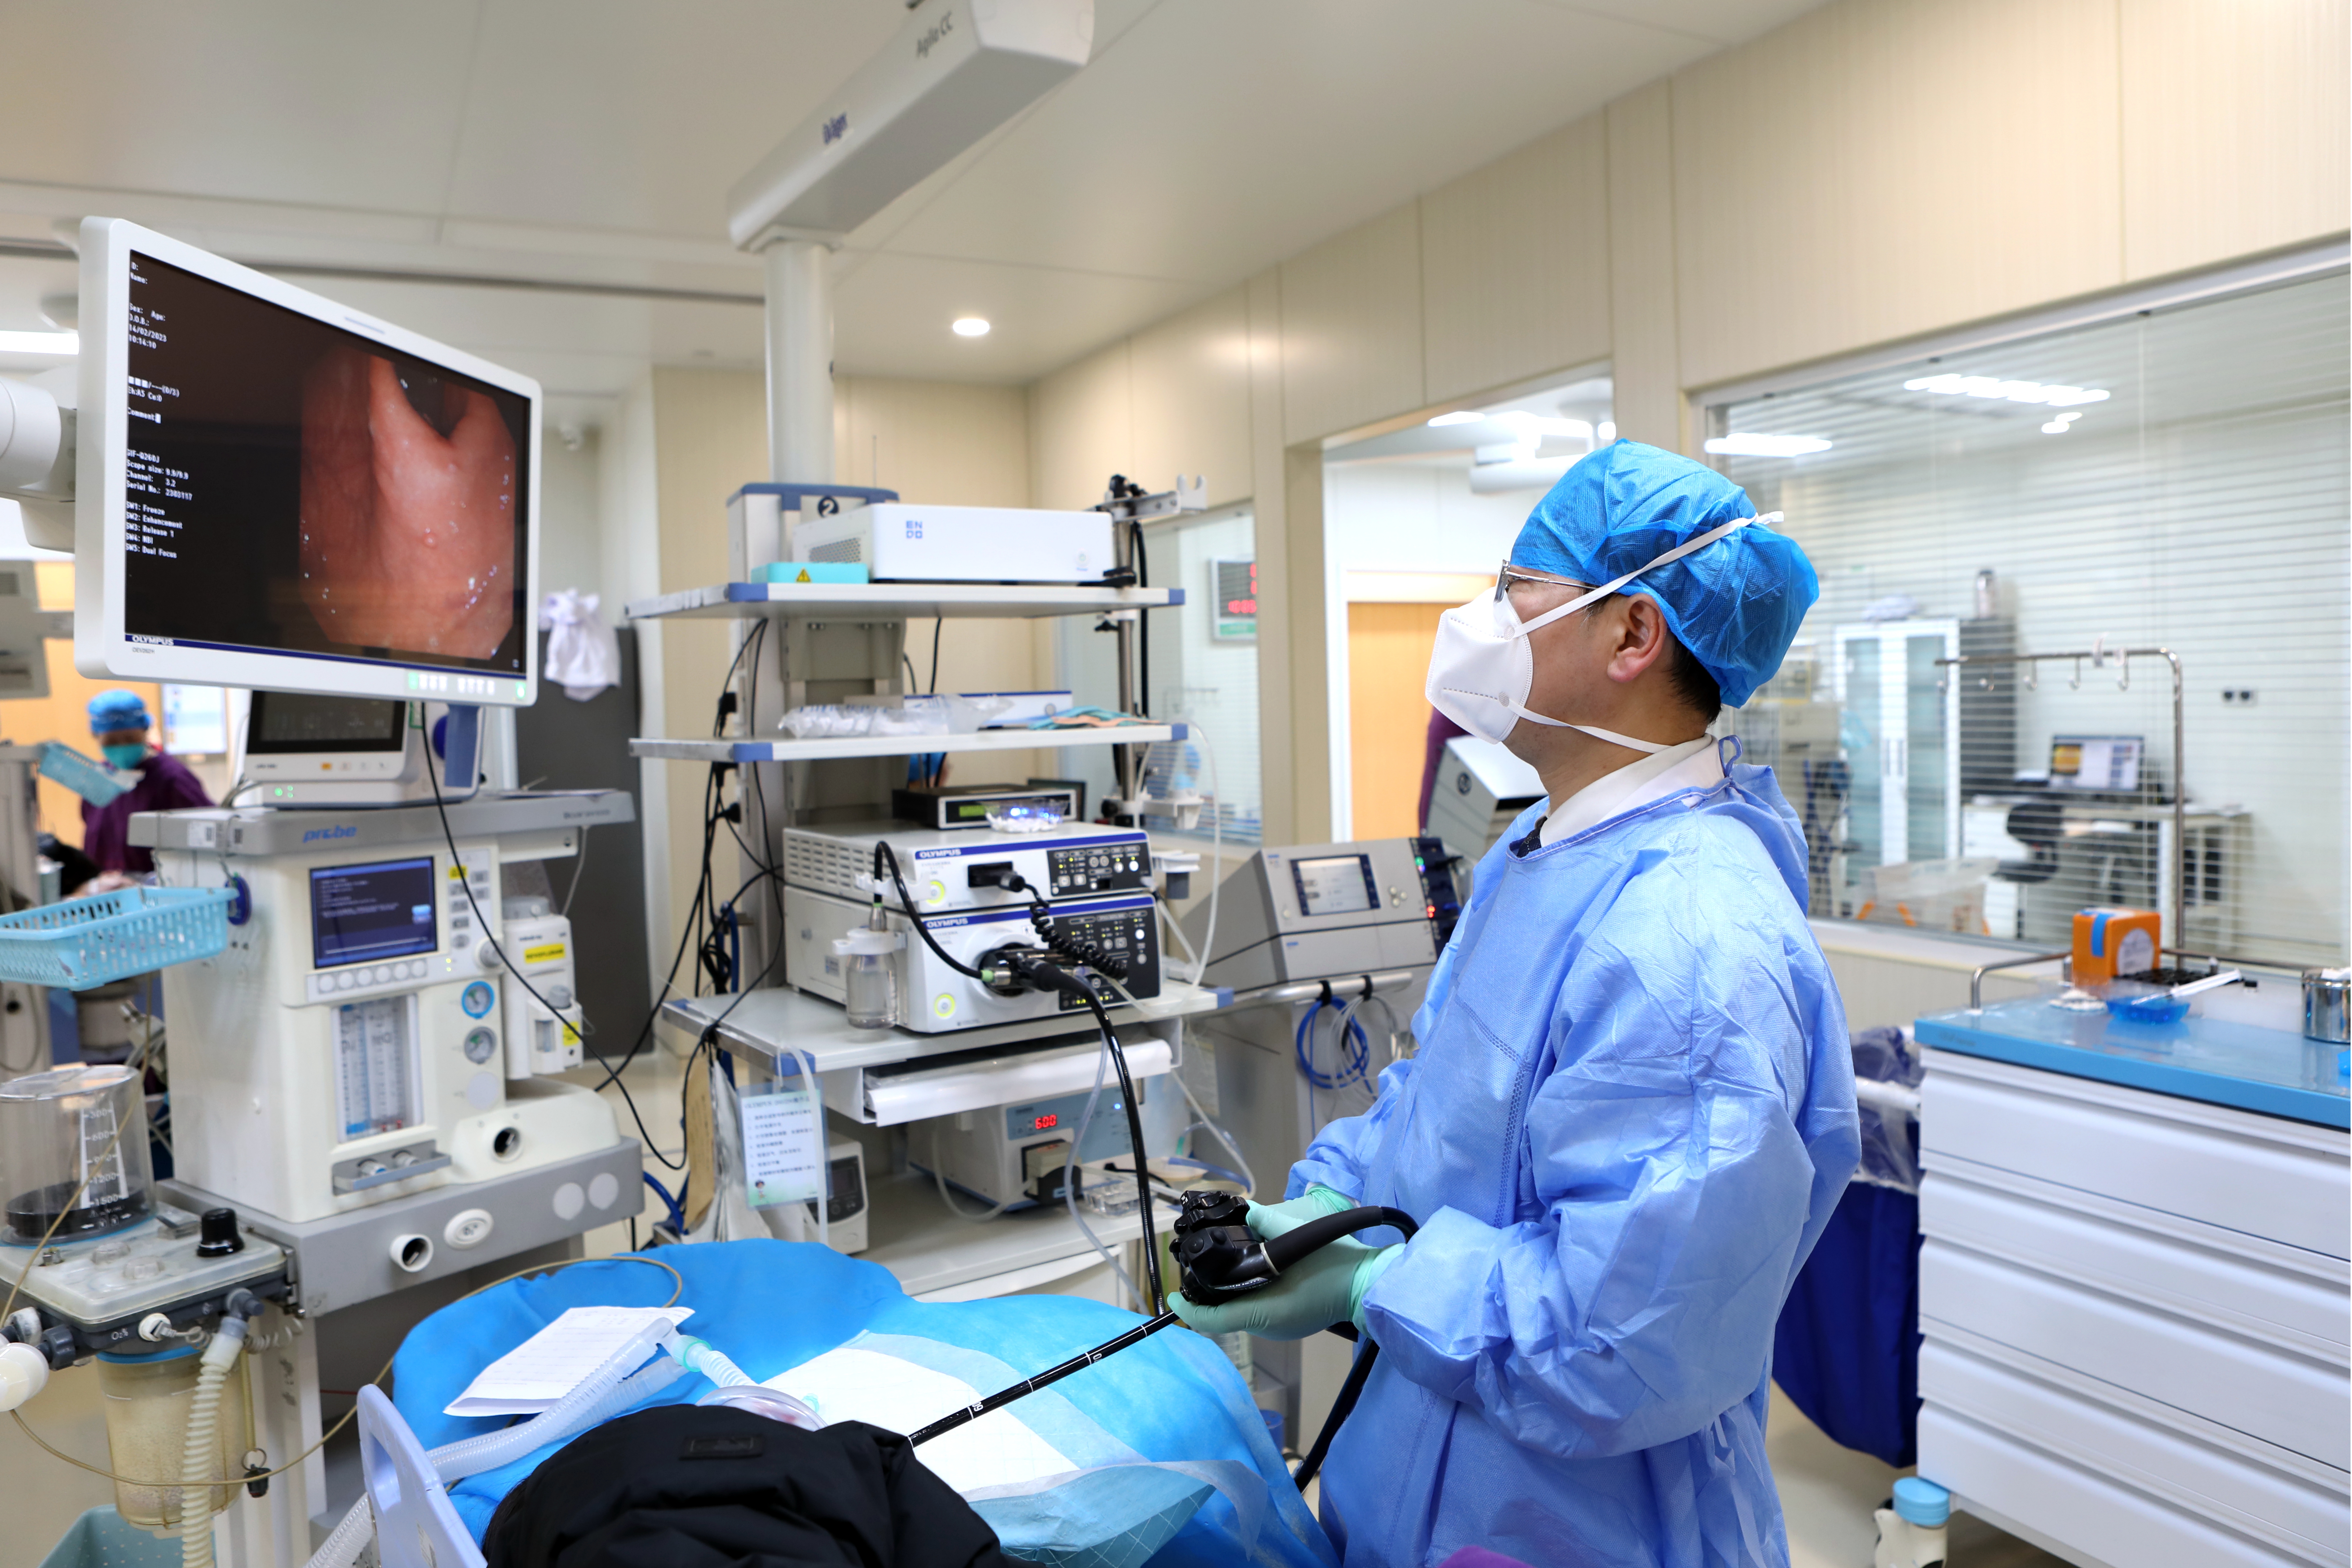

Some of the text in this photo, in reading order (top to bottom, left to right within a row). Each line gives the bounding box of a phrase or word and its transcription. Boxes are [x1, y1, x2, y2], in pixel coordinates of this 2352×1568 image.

[130, 272, 147, 284] Name:
[129, 302, 165, 321] Sex: Age:
[129, 323, 167, 343] 14/02/2023
[129, 334, 156, 349] 10:14:10
[127, 459, 145, 470] Scope
[148, 464, 164, 474] size:
[127, 469, 153, 482] Channel:
[127, 480, 145, 491] Serial
[165, 478, 176, 487] 3.2
[127, 501, 165, 516] SW1: Freeze
[127, 511, 183, 529] SW2: Enhancement
[126, 522, 174, 538] SW3: Release 1
[126, 532, 153, 544] SW4: NBI
[126, 542, 177, 558] SW5: Dual Focus
[132, 635, 174, 646] OLYMPUS
[919, 848, 961, 858] OLYMPUS
[926, 918, 968, 928] OLYMPUS
[94, 1193, 119, 1206] 1500
[972, 1401, 983, 1412] 60
